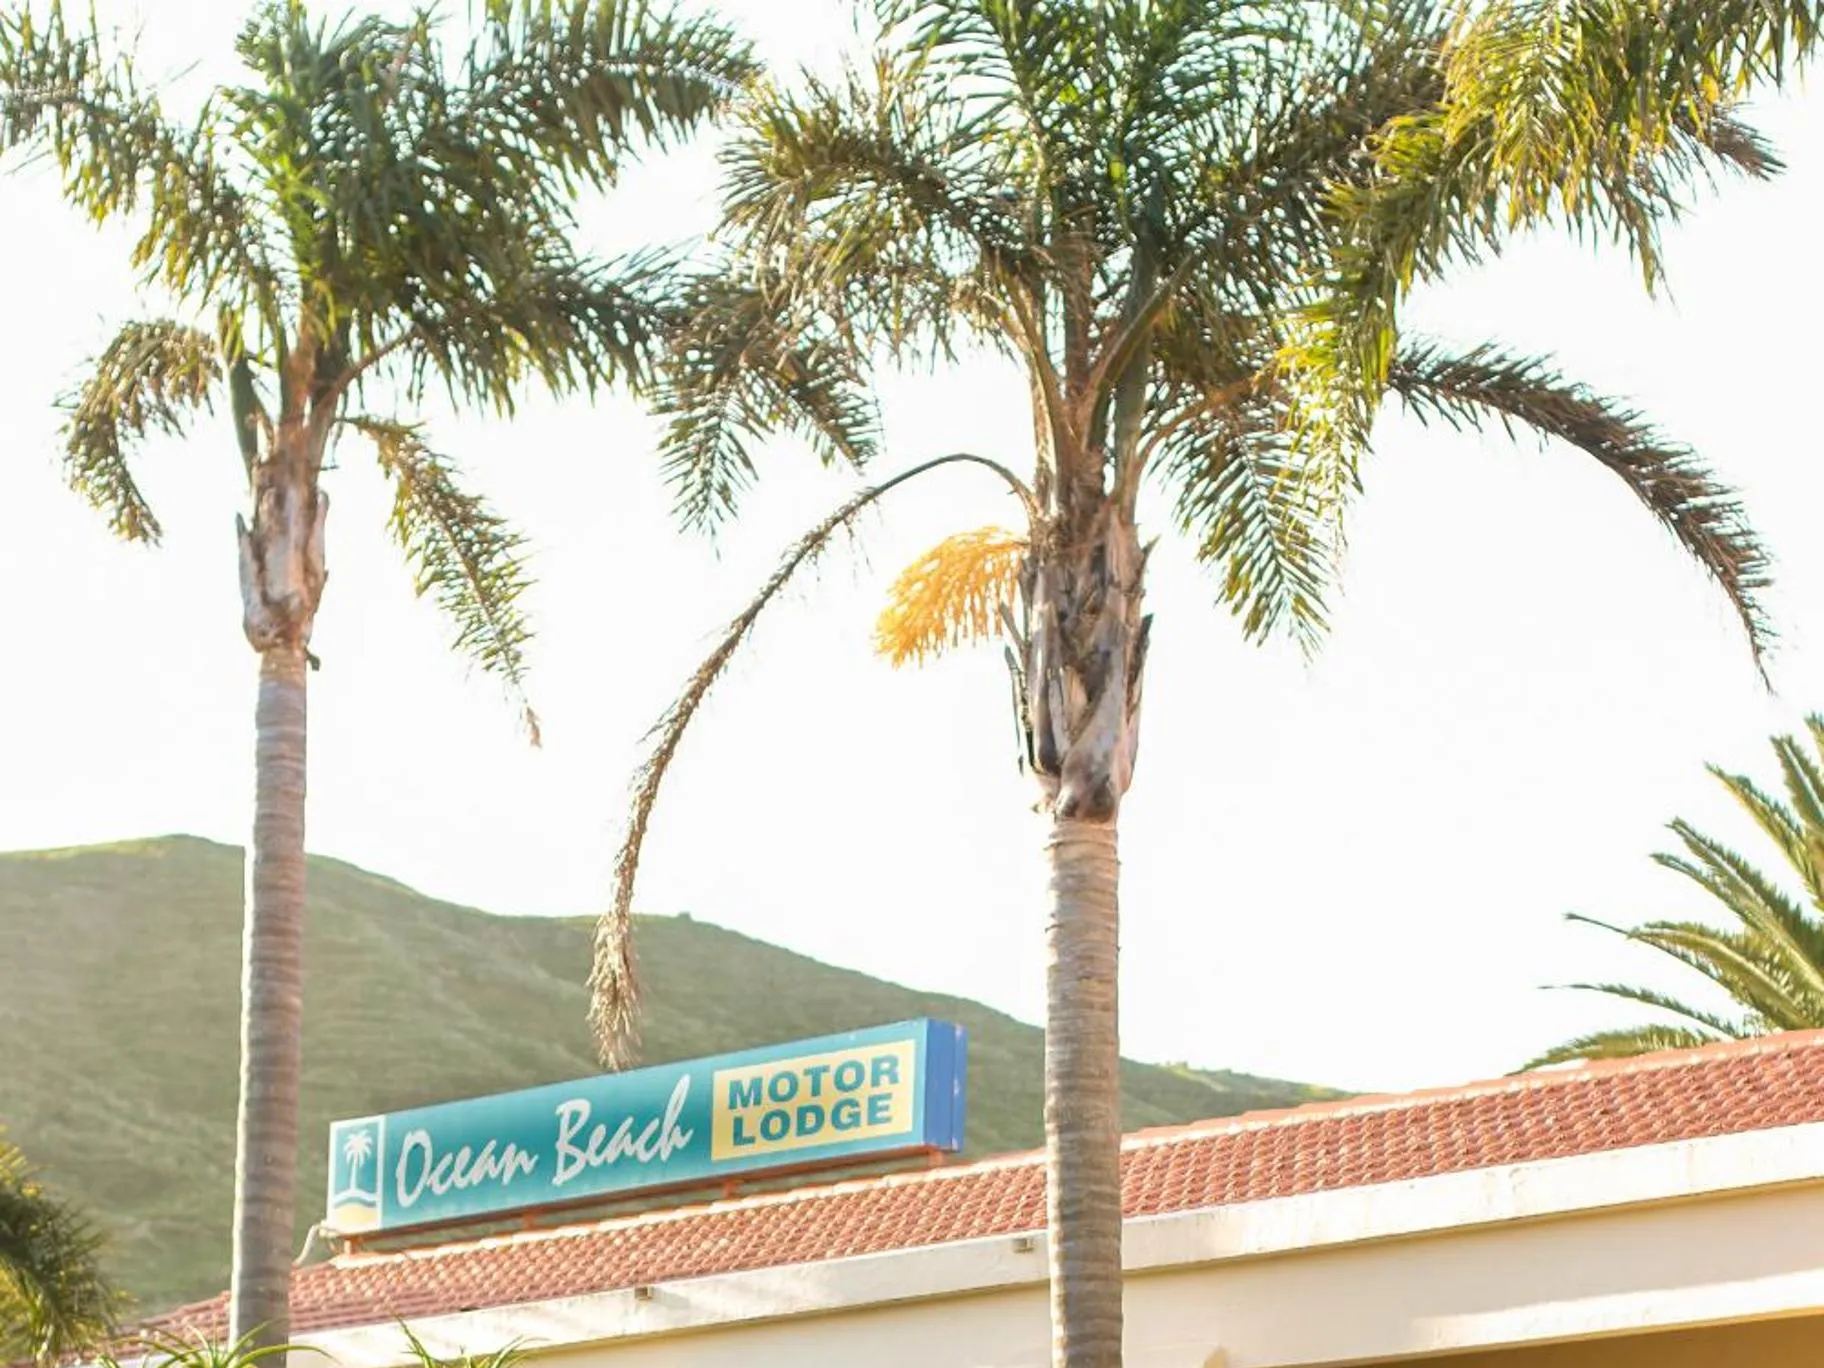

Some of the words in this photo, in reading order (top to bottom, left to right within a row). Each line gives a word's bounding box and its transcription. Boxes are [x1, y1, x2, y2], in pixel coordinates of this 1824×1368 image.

[727, 1054, 900, 1111] MOTOR
[396, 1129, 538, 1208] Ocean
[551, 1073, 693, 1187] Beach
[732, 1092, 893, 1148] LODGE
